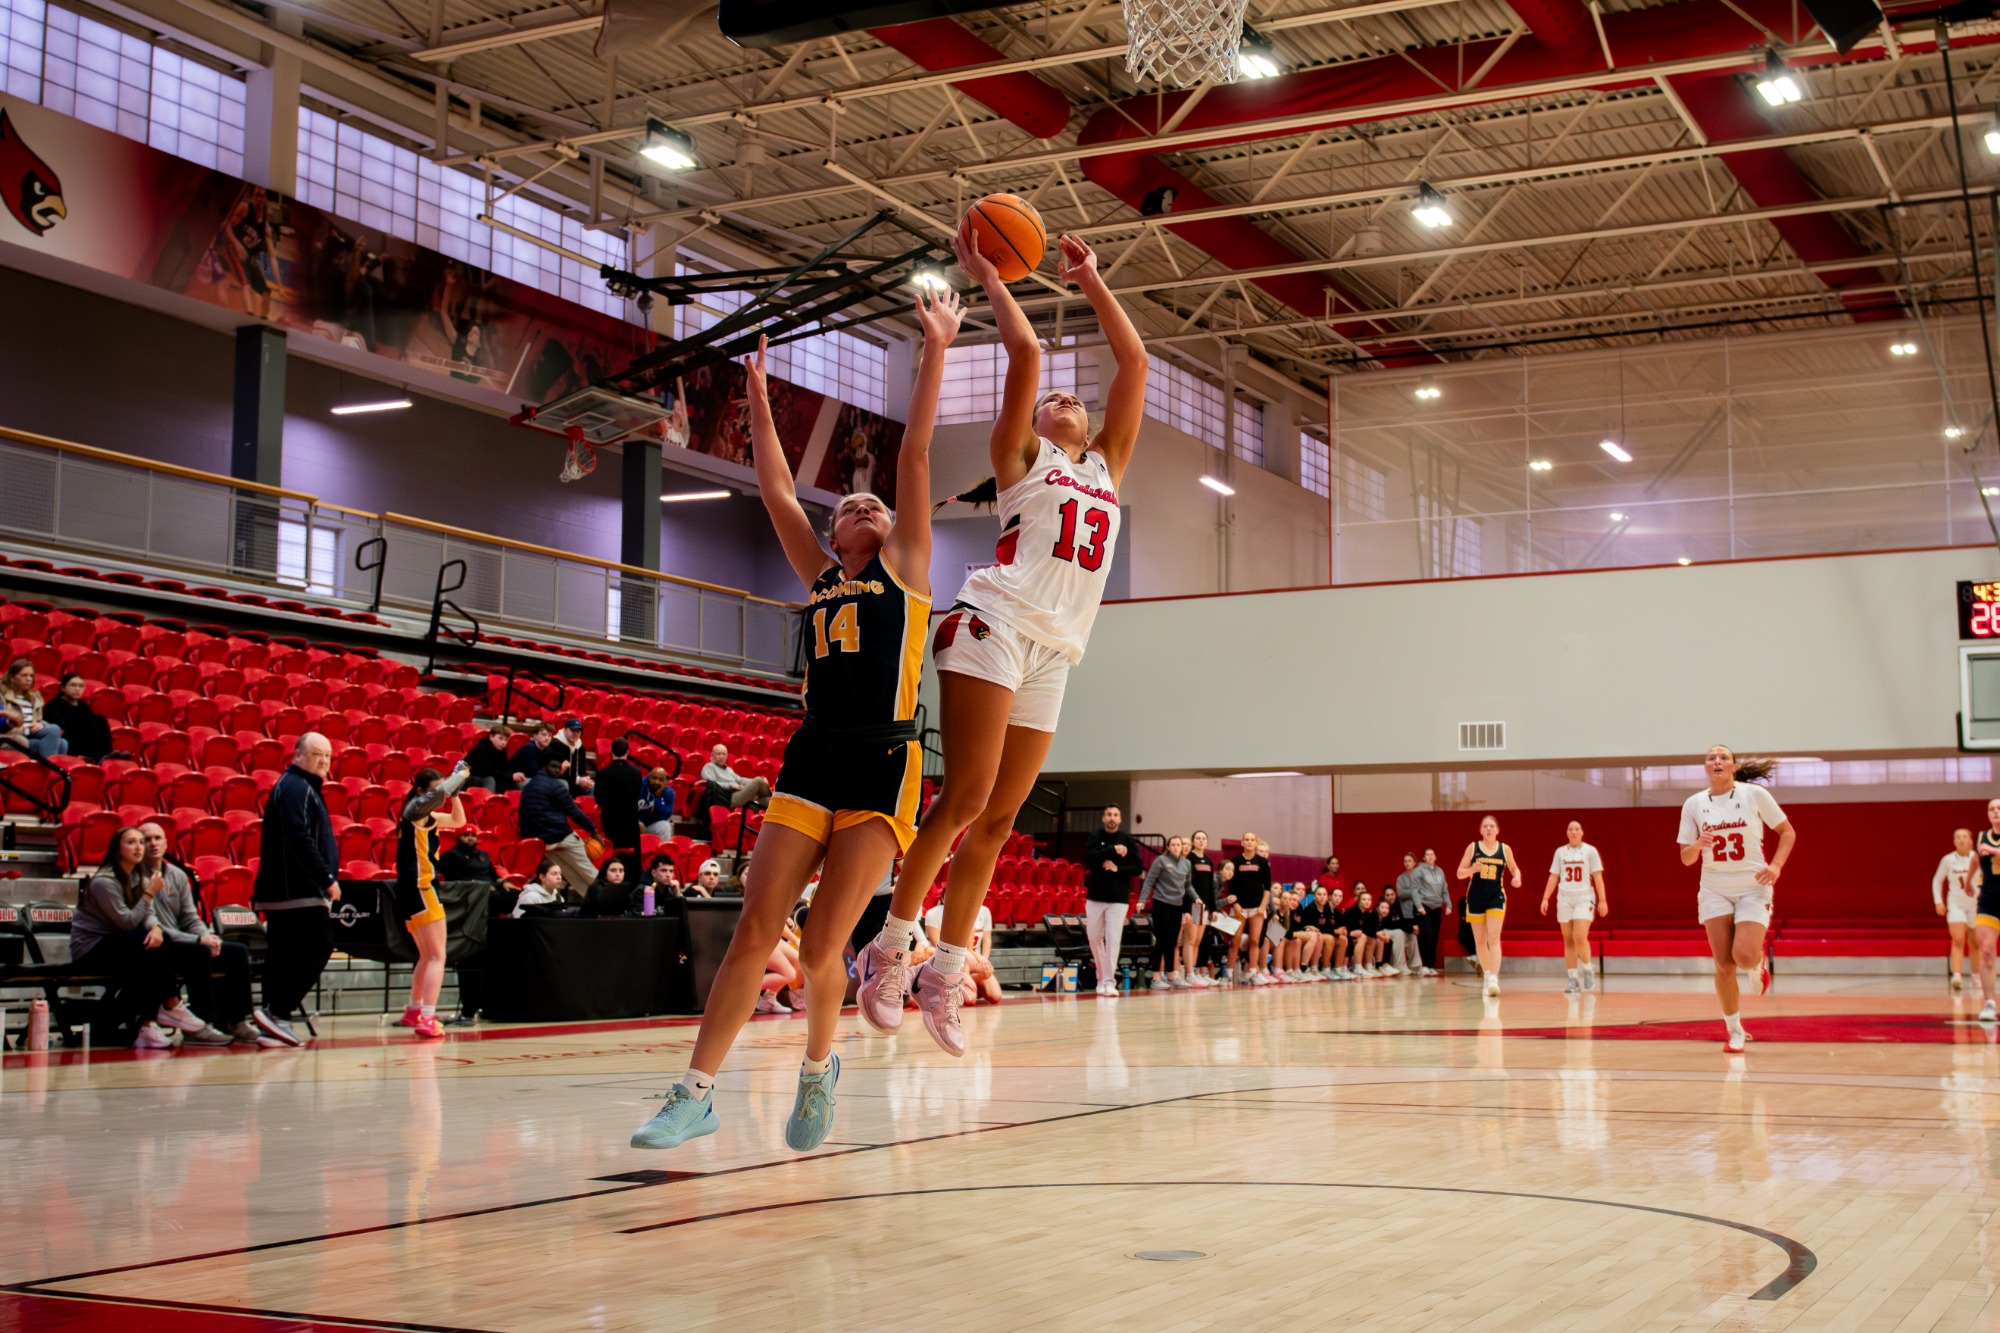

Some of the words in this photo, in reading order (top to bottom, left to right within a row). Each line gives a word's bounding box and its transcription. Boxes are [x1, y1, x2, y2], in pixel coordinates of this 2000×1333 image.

[1052, 498, 1110, 573] 13
[812, 602, 860, 660] 14
[1712, 832, 1745, 862] 23
[1565, 866, 1583, 882] 30
[31, 909, 73, 922] CATHOLIC
